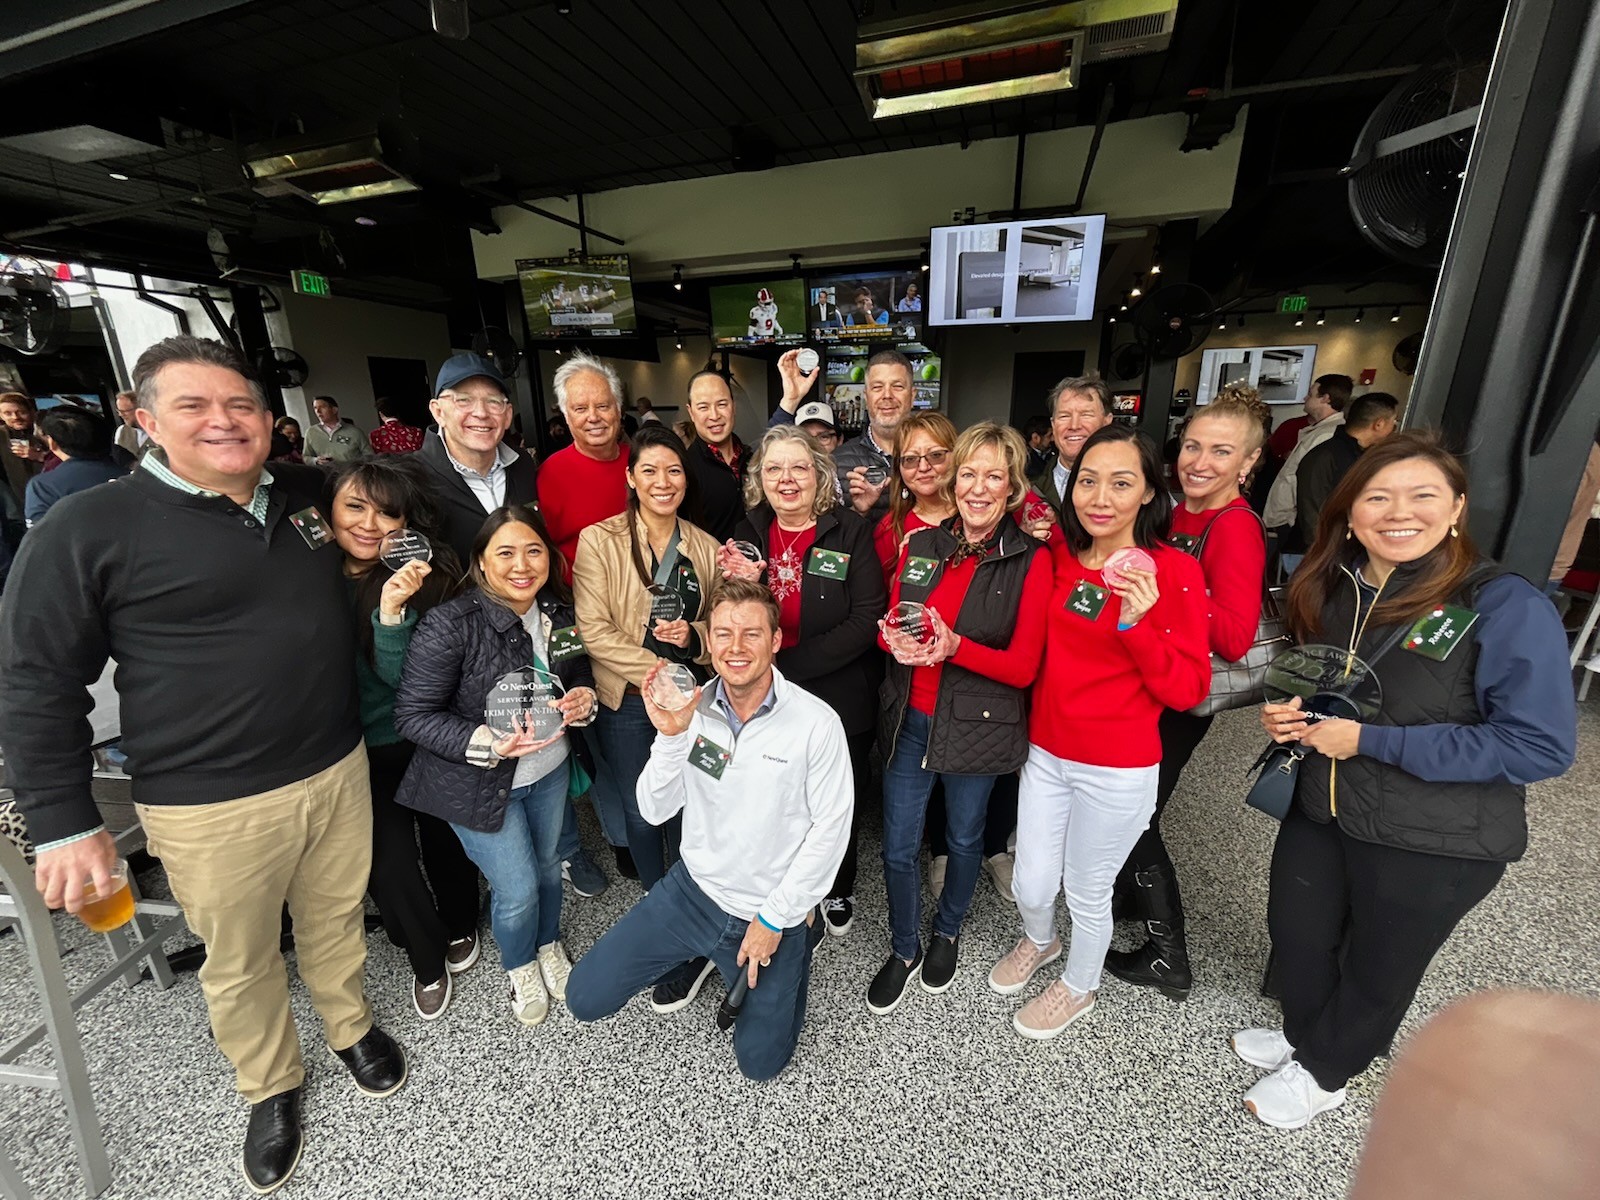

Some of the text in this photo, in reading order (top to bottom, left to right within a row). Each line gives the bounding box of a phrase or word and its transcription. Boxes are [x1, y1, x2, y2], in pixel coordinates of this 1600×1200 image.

[301, 273, 325, 295] EXIT
[1282, 297, 1306, 311] EXIT
[765, 318, 773, 330] 9
[895, 612, 922, 623] NewQuest
[1428, 617, 1453, 645] Rebecca
[510, 682, 553, 692] NewQuest
[496, 694, 556, 704] SERVICE AWARD
[507, 706, 561, 716] NGUYEN-THA
[767, 755, 788, 764] NewQuest
